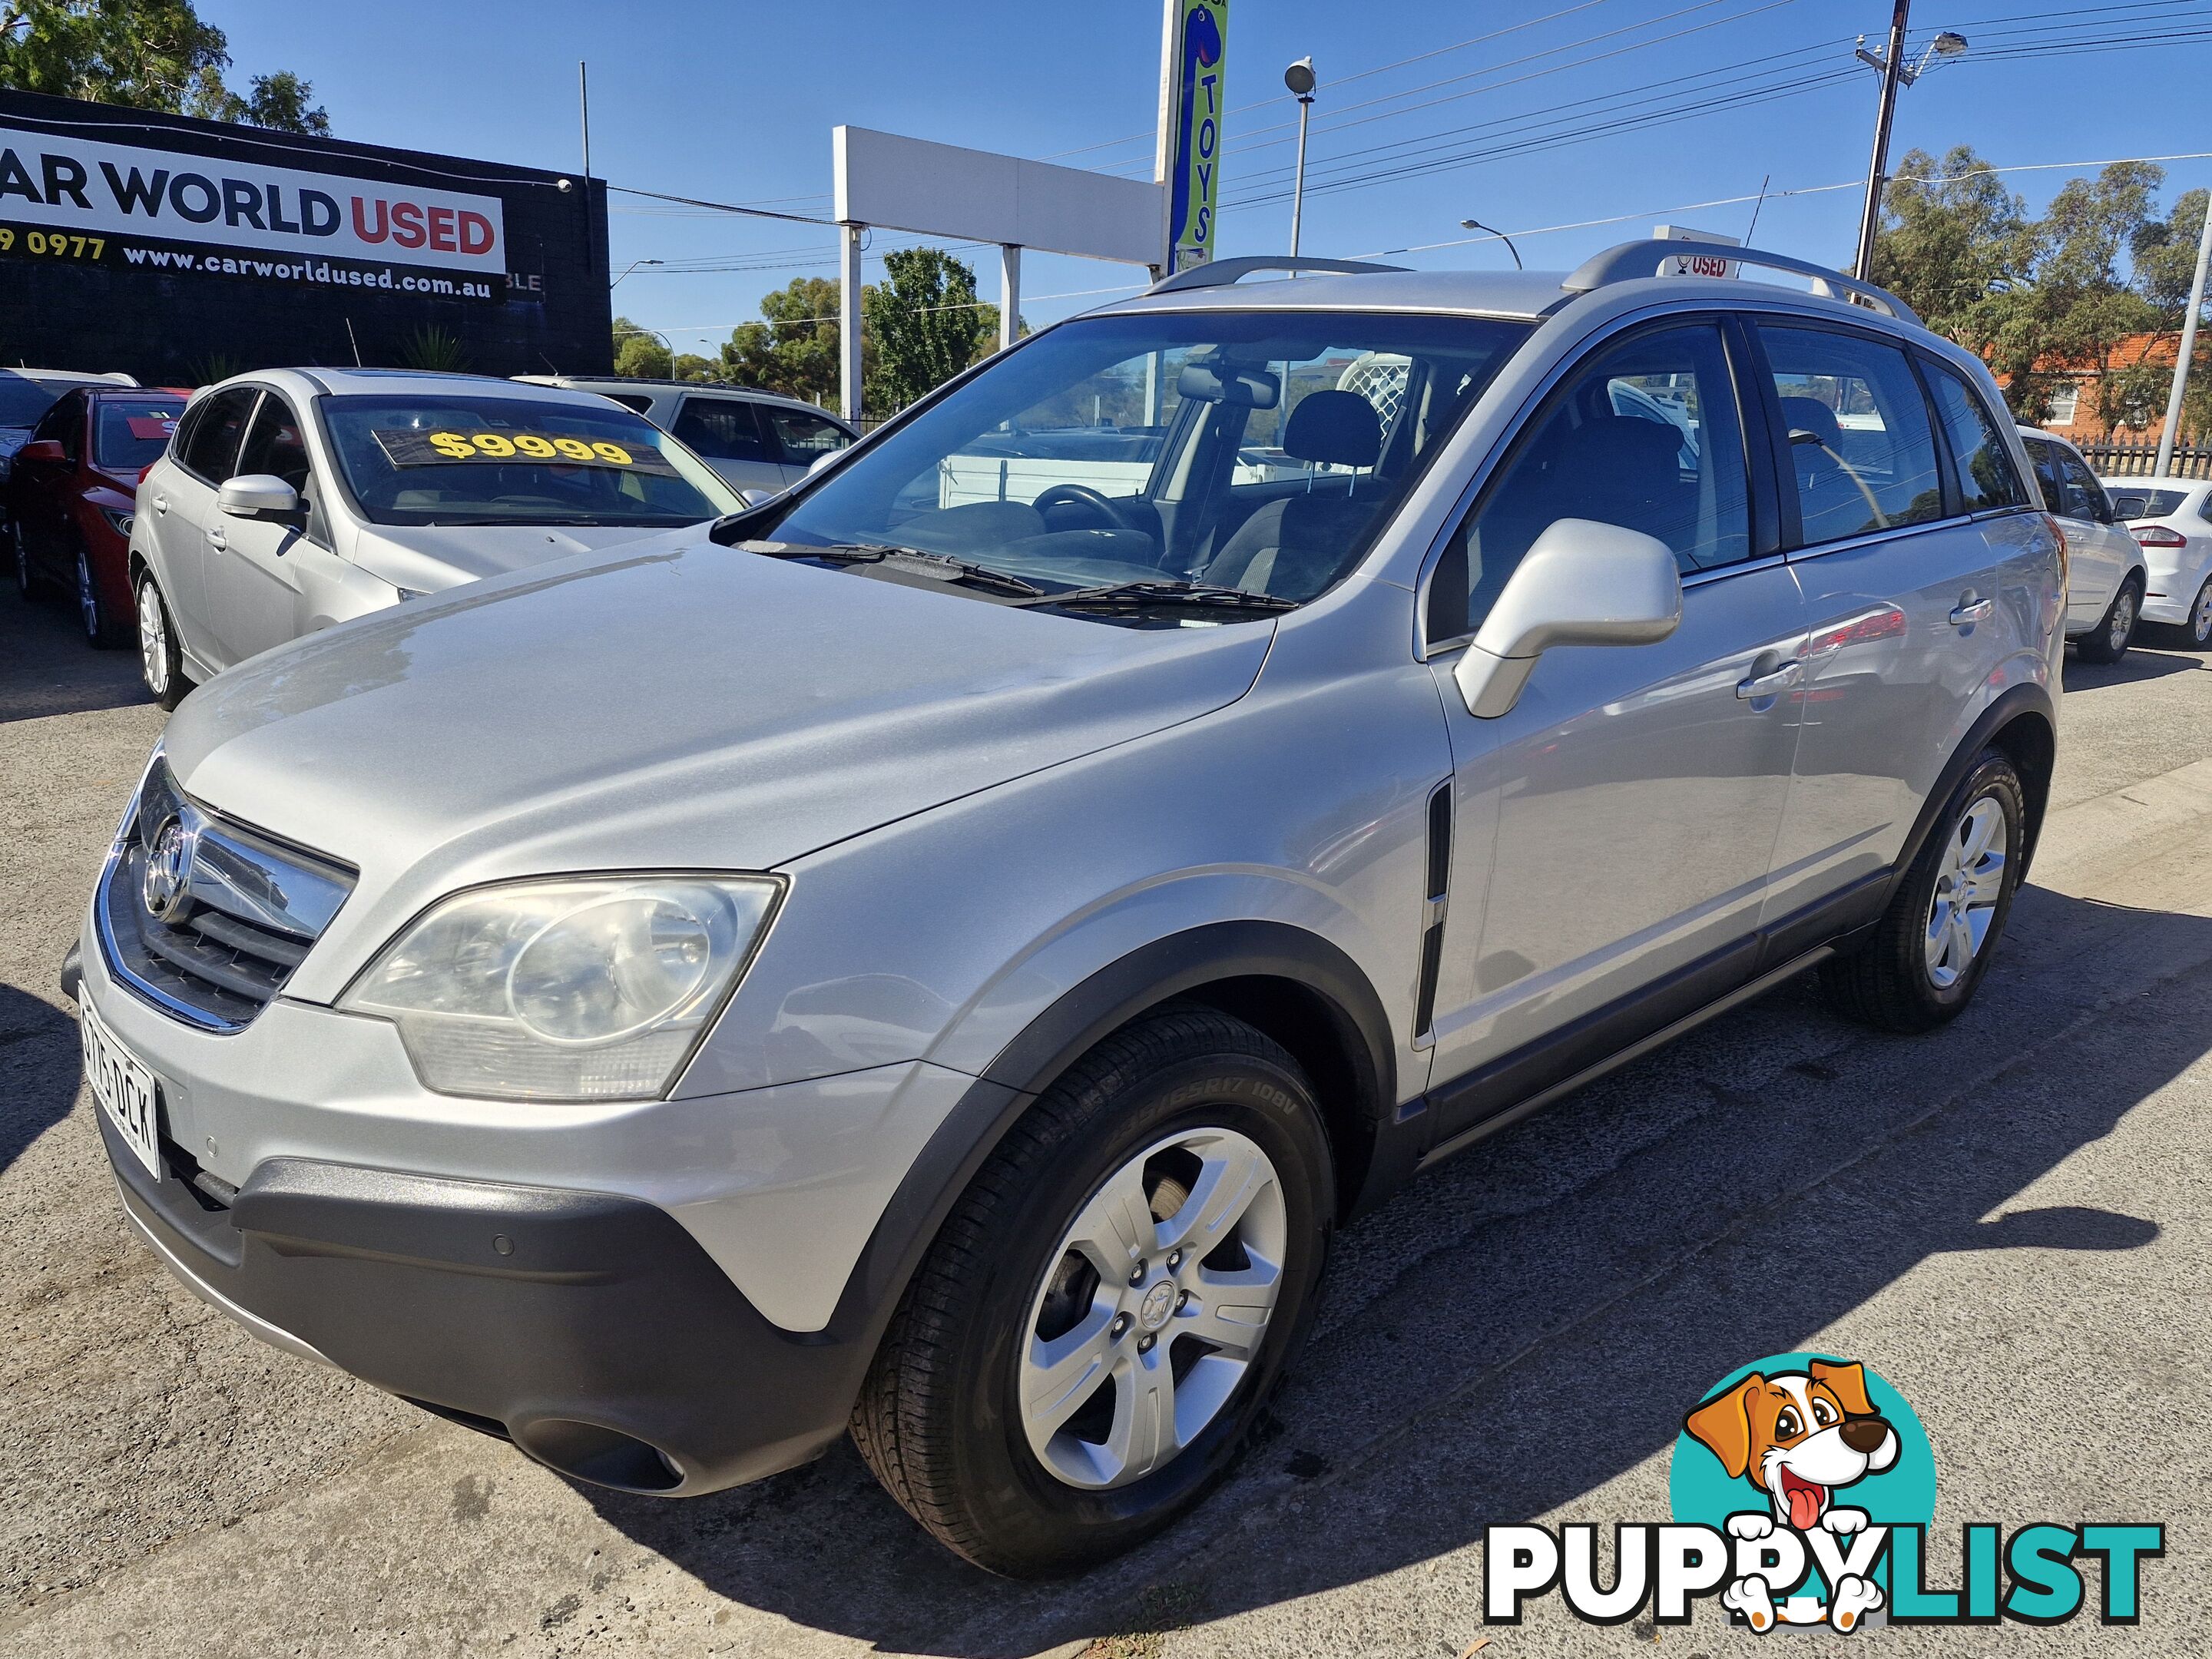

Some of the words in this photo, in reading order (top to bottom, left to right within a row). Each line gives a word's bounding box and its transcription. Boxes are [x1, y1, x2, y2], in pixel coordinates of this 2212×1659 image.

[1194, 74, 1217, 243] TOYS
[98, 161, 342, 237] WORLD
[352, 197, 495, 255] USED
[28, 232, 104, 260] 0977
[123, 247, 491, 299] www.carworldused.com.au
[1692, 257, 1727, 277] USED
[429, 432, 633, 465] $9999
[1250, 1081, 1299, 1116] 108V
